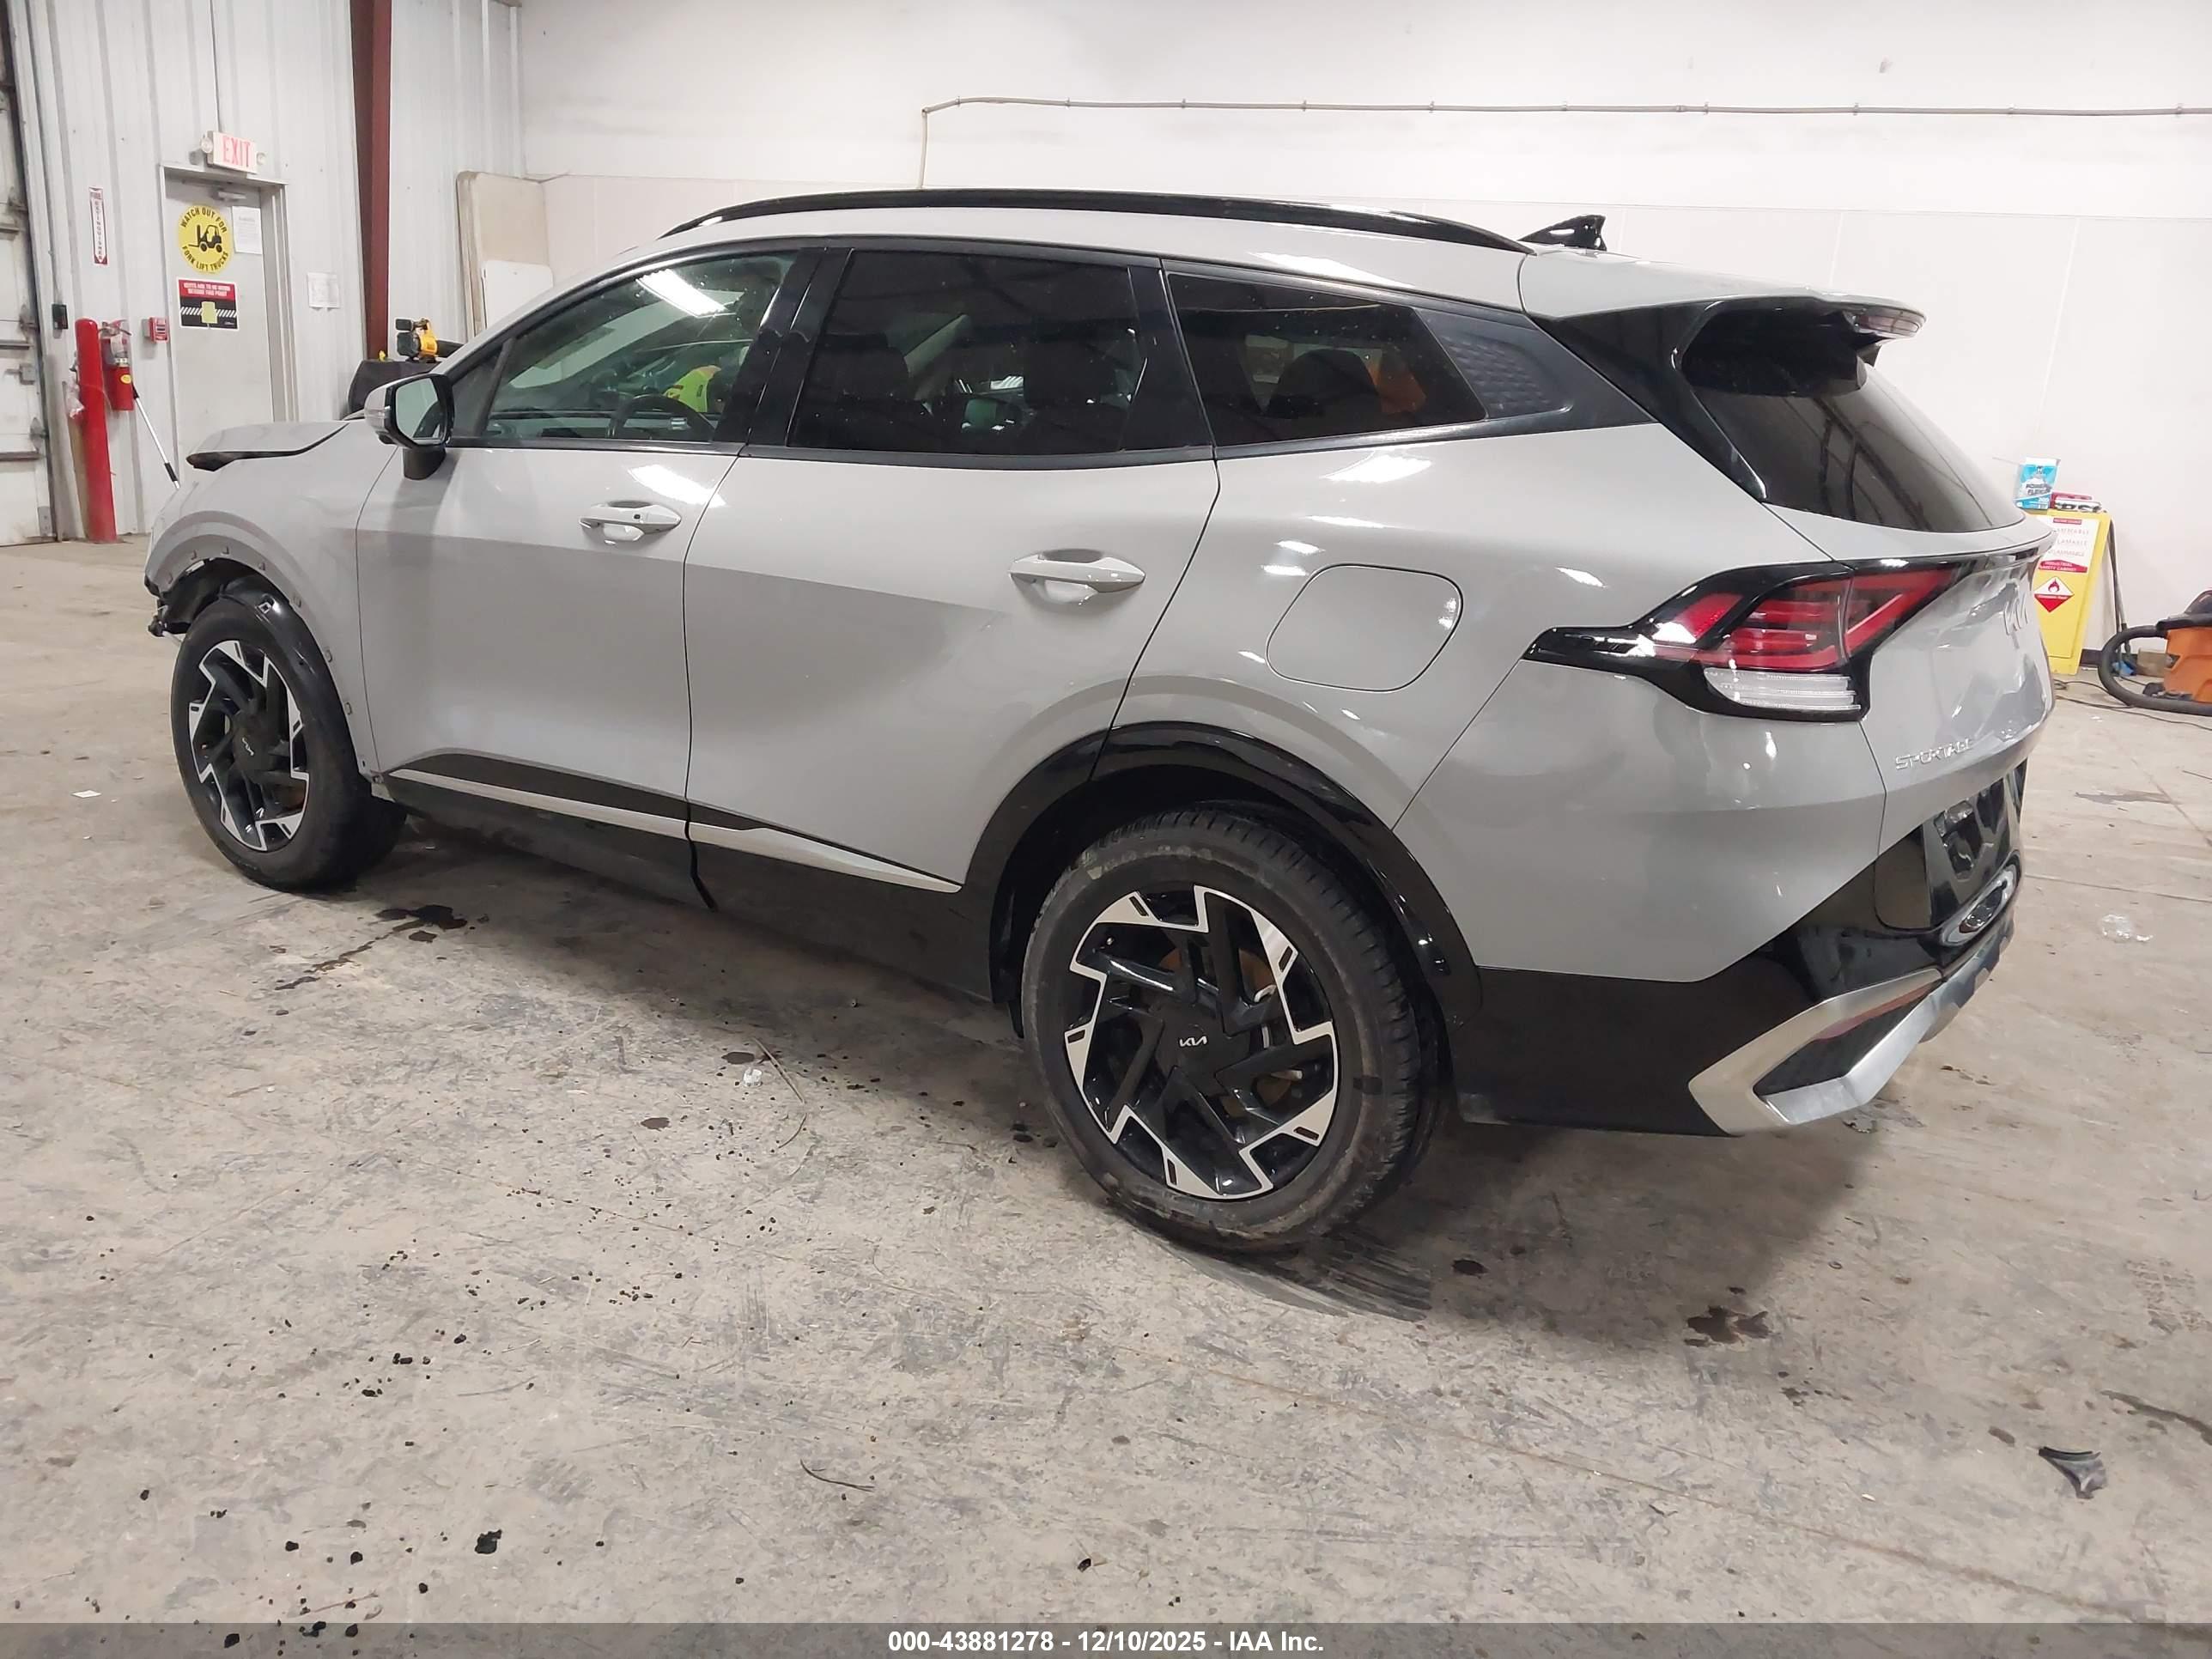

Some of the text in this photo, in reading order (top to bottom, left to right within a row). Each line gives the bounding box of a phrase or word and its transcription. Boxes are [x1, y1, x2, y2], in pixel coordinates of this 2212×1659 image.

[222, 136, 250, 167] EXIT
[180, 207, 228, 233] WATCH OUT FOR
[182, 246, 229, 271] FORK LIFT TRUCKS
